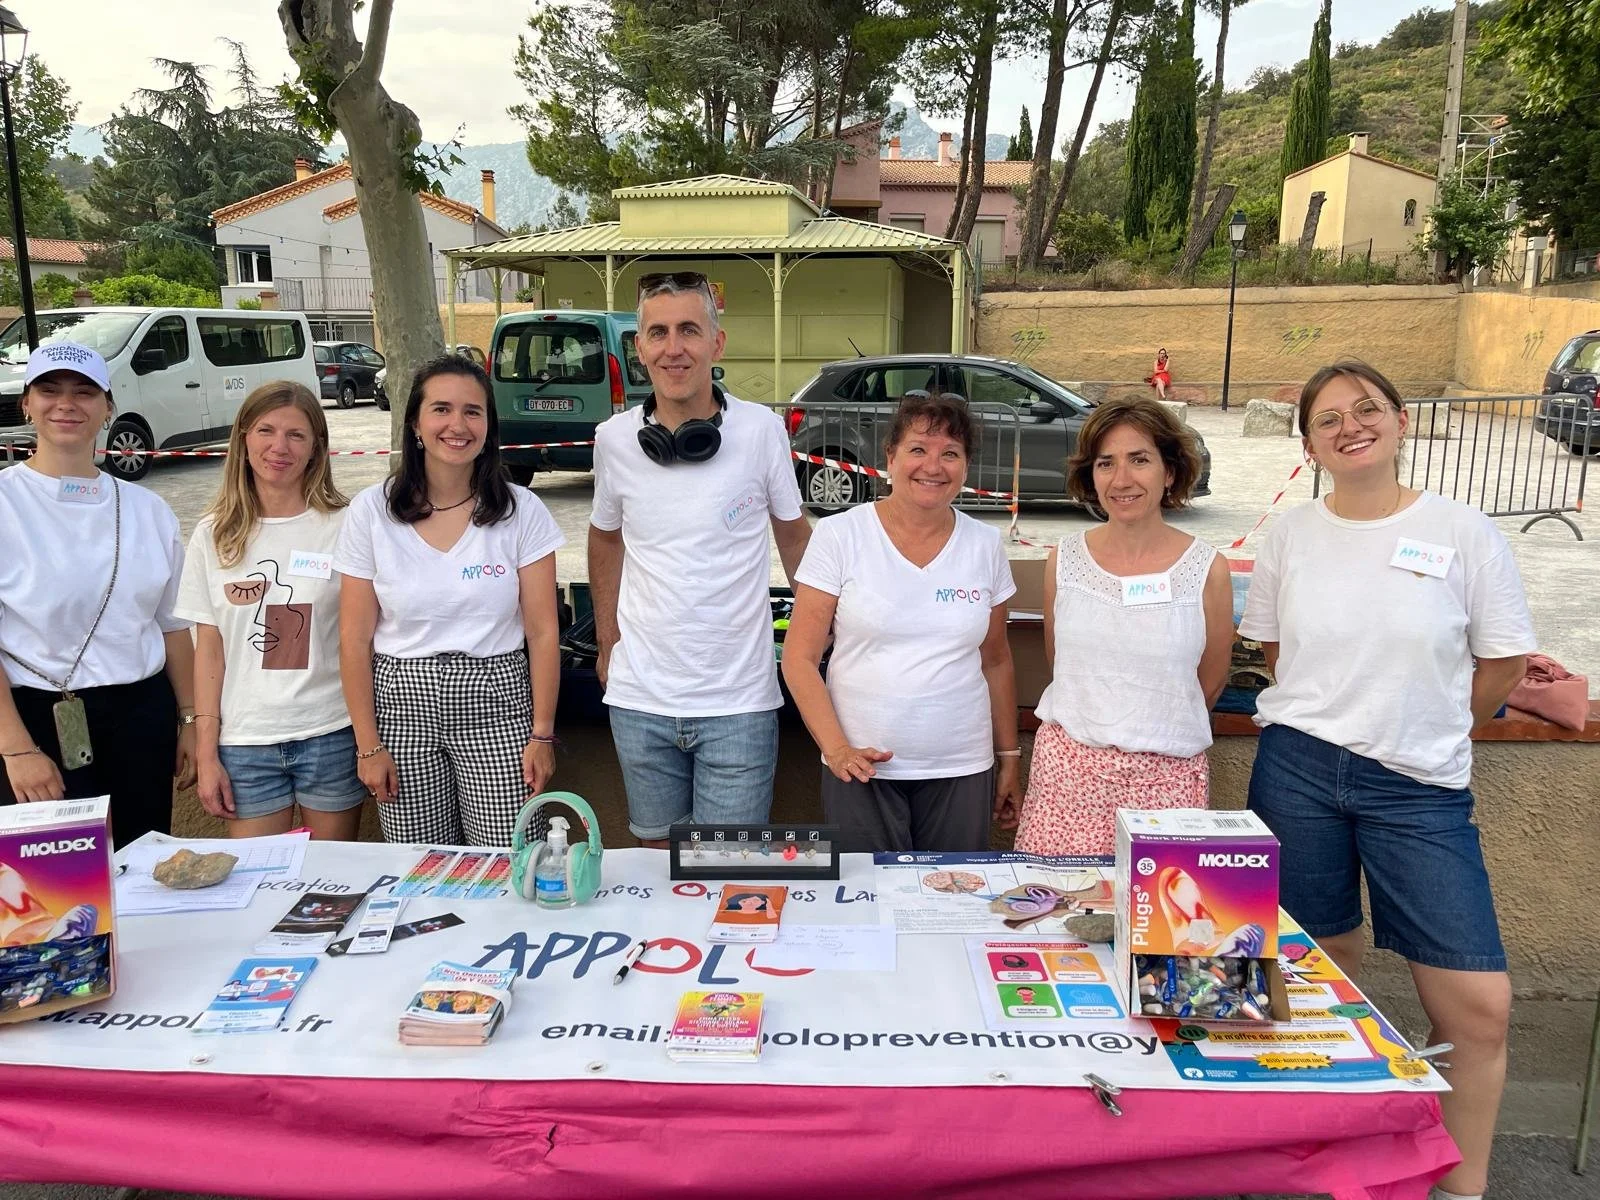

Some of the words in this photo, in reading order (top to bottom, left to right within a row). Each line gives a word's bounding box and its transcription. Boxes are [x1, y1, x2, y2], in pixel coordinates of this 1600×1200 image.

[41, 346, 93, 358] FONDATION
[48, 350, 87, 361] MISSION
[63, 482, 99, 495] APPOLO
[1400, 547, 1444, 563] APPOLO
[293, 559, 329, 571] APPOLO
[462, 564, 506, 580] APPOLO
[935, 588, 981, 604] APPOLO
[1128, 582, 1166, 597] APPOLO
[20, 837, 97, 858] MOLDEX
[1140, 862, 1153, 871] 35
[1198, 853, 1270, 868] MOLDEX
[257, 878, 351, 893] ociation
[541, 1023, 669, 1043] email:
[1213, 1032, 1223, 1040] Je
[1225, 1032, 1257, 1040] m'offre
[1259, 1032, 1273, 1040] des
[1276, 1032, 1305, 1041] plages
[1308, 1032, 1318, 1040] de
[1320, 1032, 1345, 1040] calme
